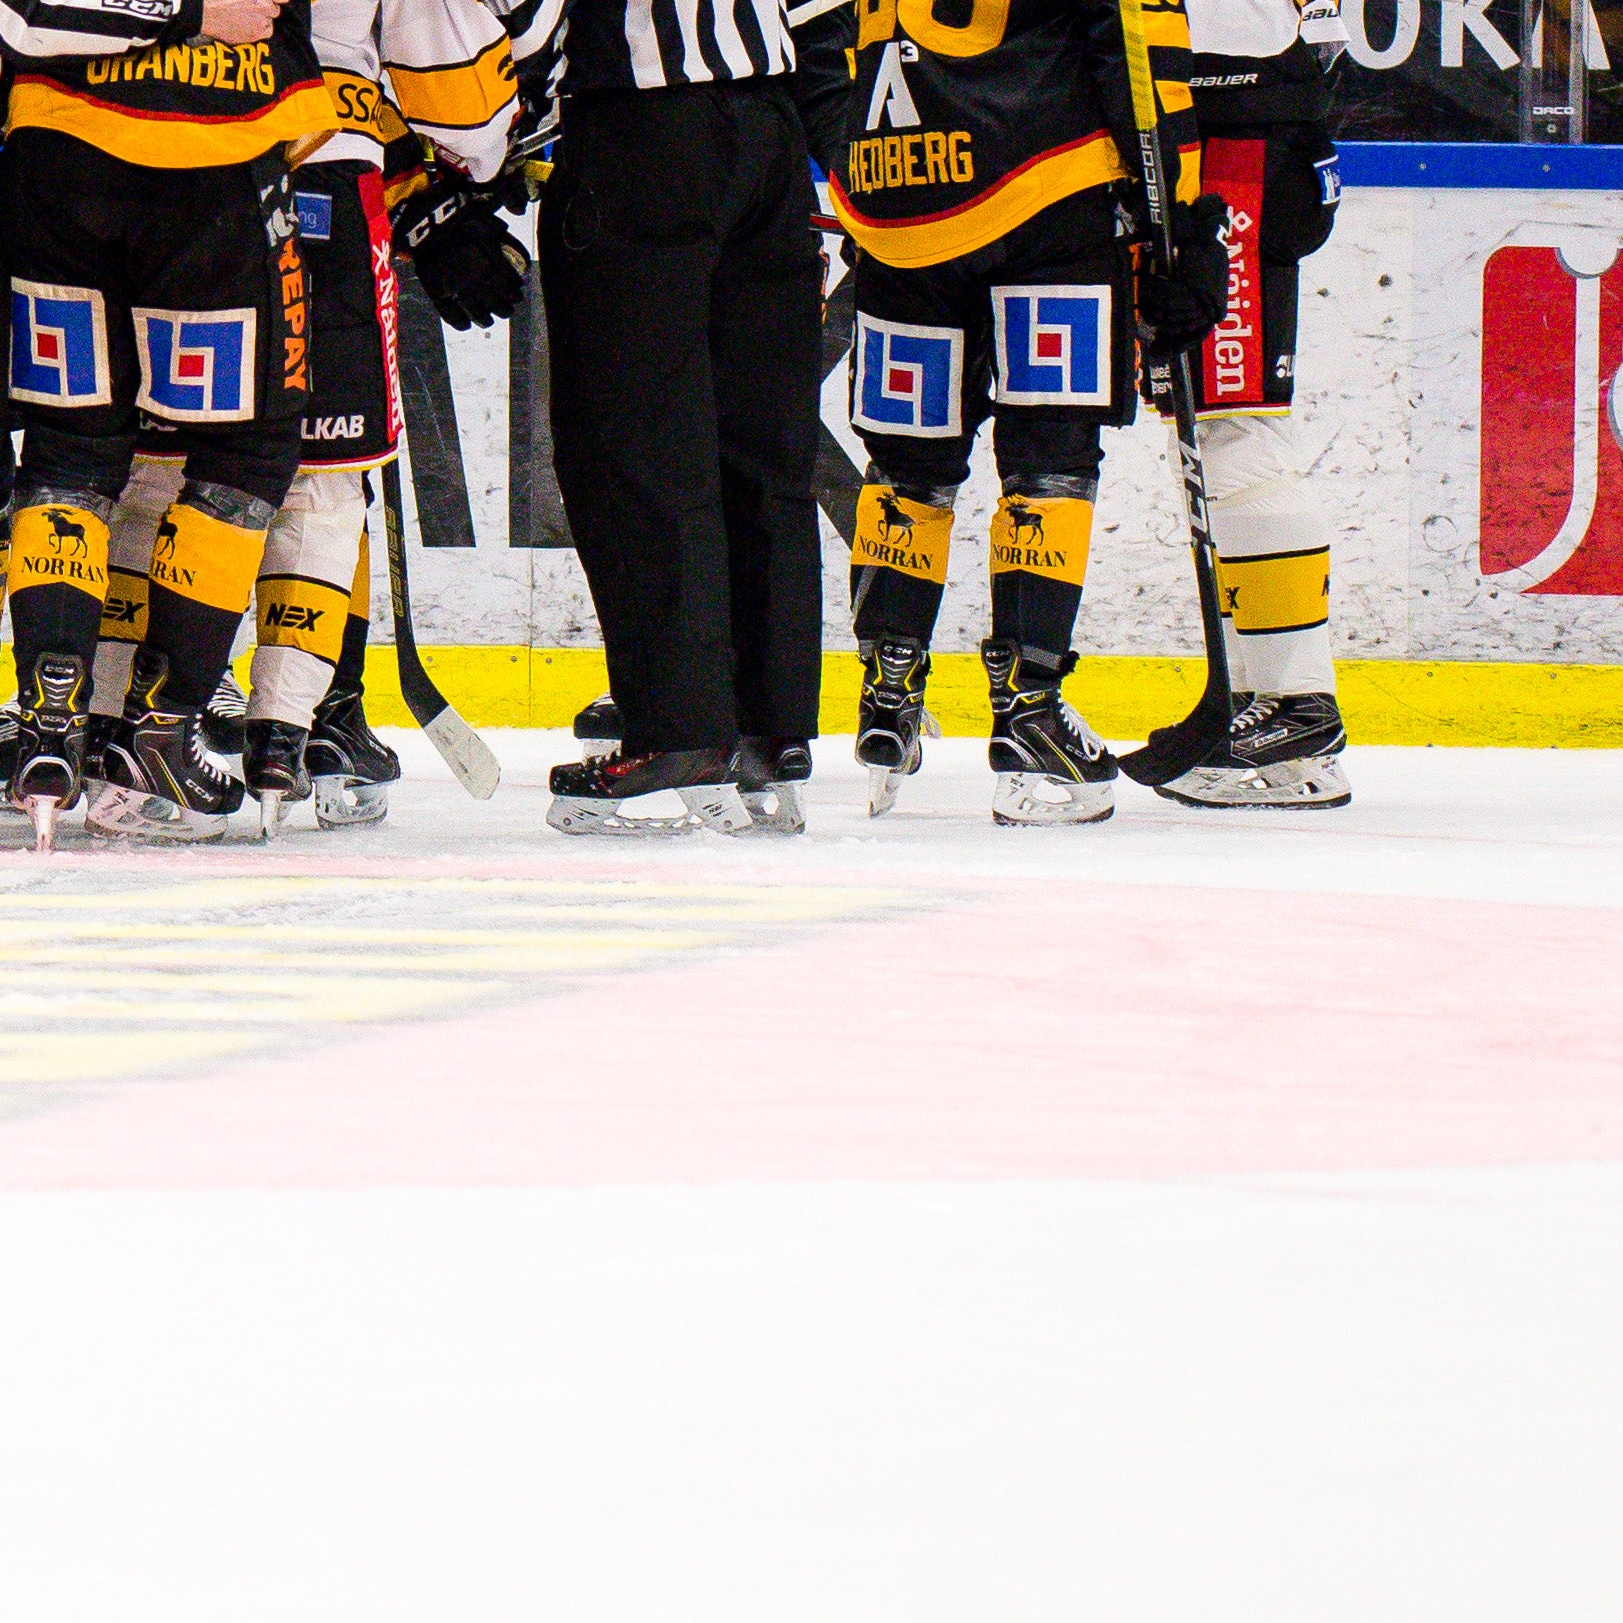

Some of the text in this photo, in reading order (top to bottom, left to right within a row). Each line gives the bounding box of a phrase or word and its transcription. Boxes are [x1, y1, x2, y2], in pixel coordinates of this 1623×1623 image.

[1187, 72, 1259, 88] BAUER
[848, 130, 974, 194] HEDBERG
[300, 414, 365, 440] LKAB
[858, 535, 935, 571] NORRAN
[992, 542, 1068, 569] NORRAN
[20, 555, 105, 585] NORRAN
[264, 602, 326, 633] NEX
